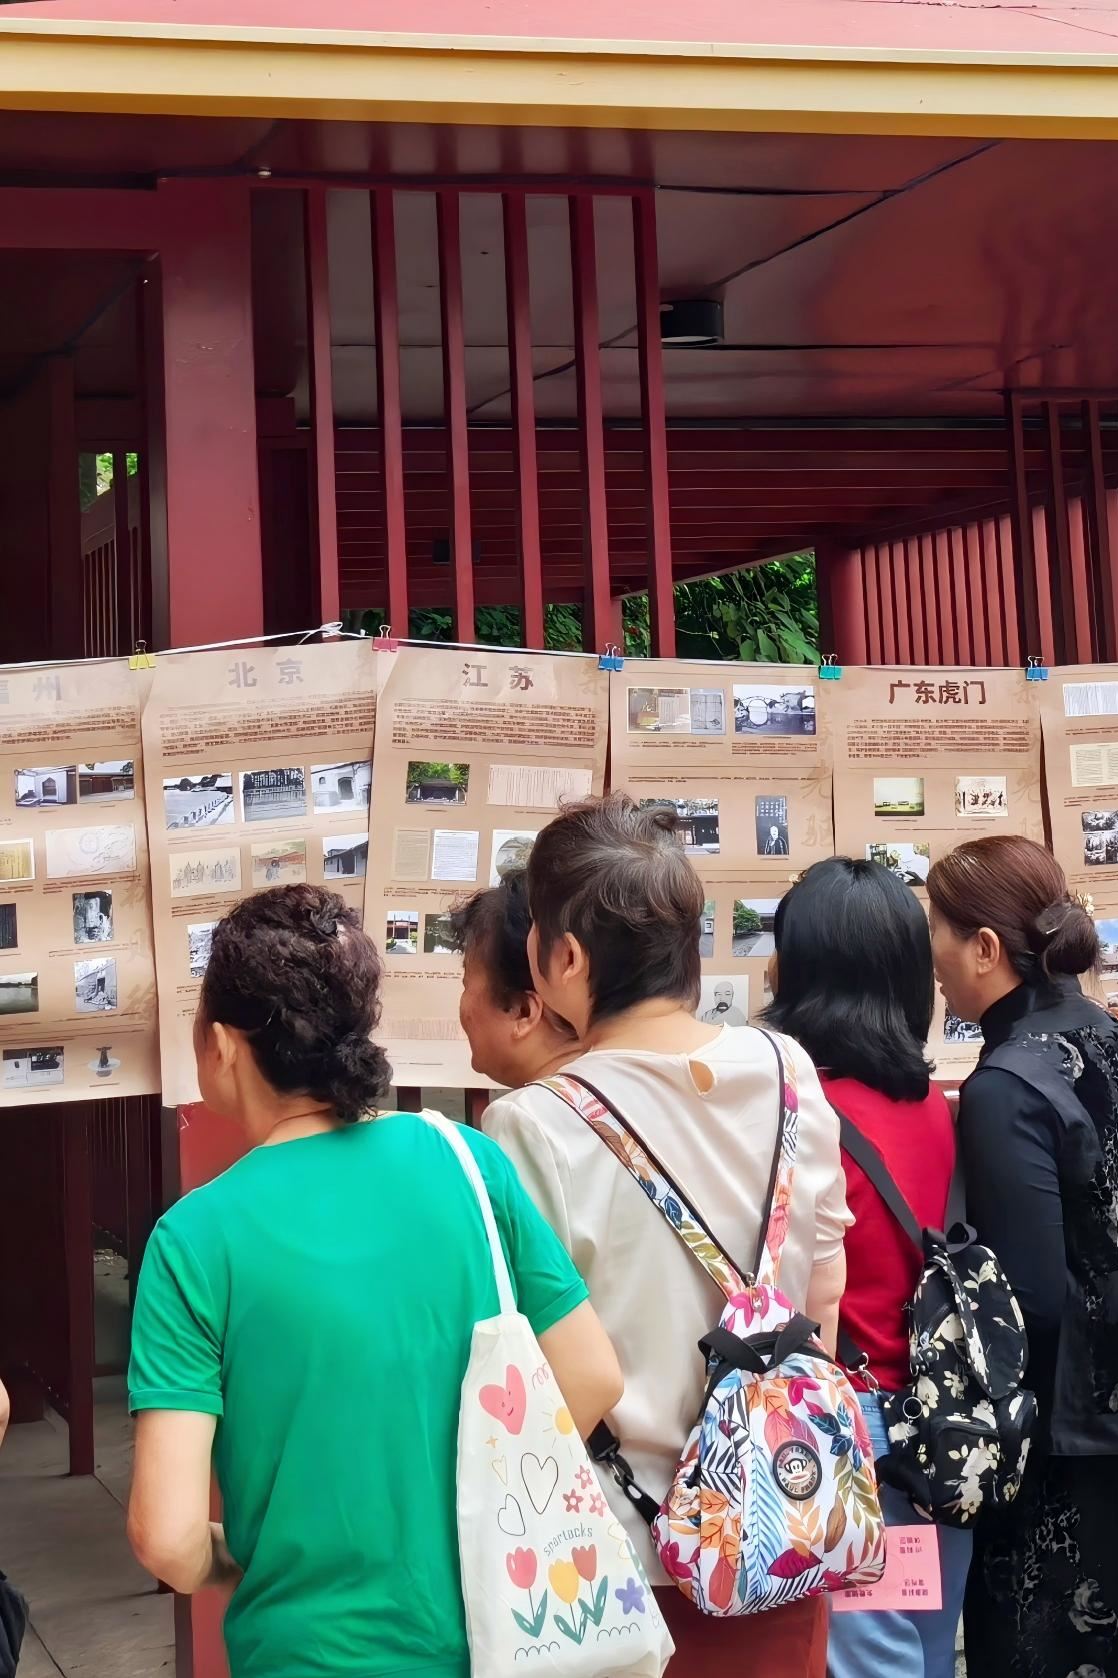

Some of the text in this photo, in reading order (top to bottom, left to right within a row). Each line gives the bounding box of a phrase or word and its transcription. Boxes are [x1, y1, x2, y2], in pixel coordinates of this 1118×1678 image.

[228, 658, 304, 688] 北京
[462, 663, 534, 691] 江苏
[889, 680, 987, 704] 广东虎门
